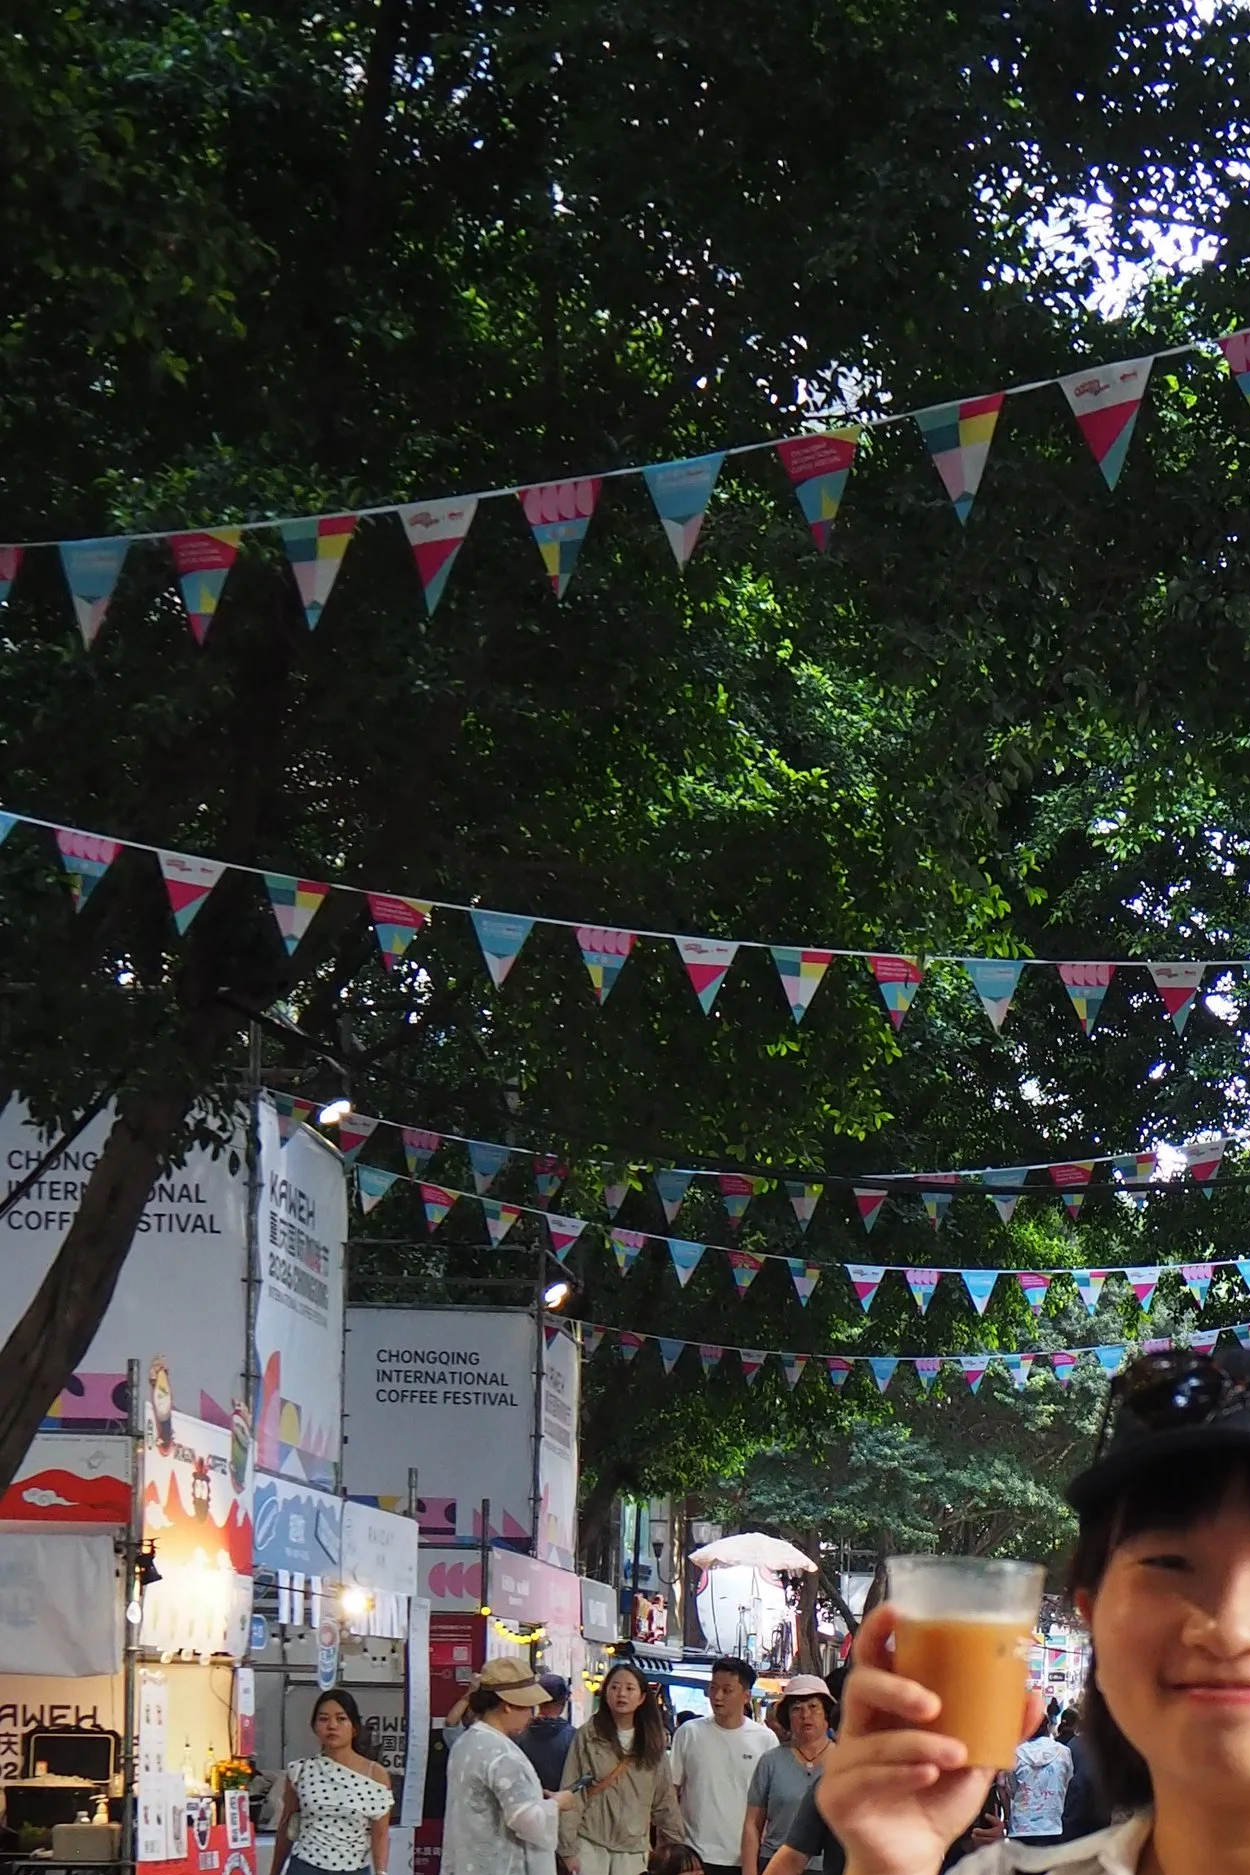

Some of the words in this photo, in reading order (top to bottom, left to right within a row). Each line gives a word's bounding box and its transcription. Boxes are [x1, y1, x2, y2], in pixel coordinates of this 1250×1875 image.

[376, 1349, 480, 1367] CHONGQING
[376, 1369, 510, 1387] INTERNATIONAL
[376, 1389, 438, 1405] COFFEE
[443, 1391, 519, 1407] FESTIVAL
